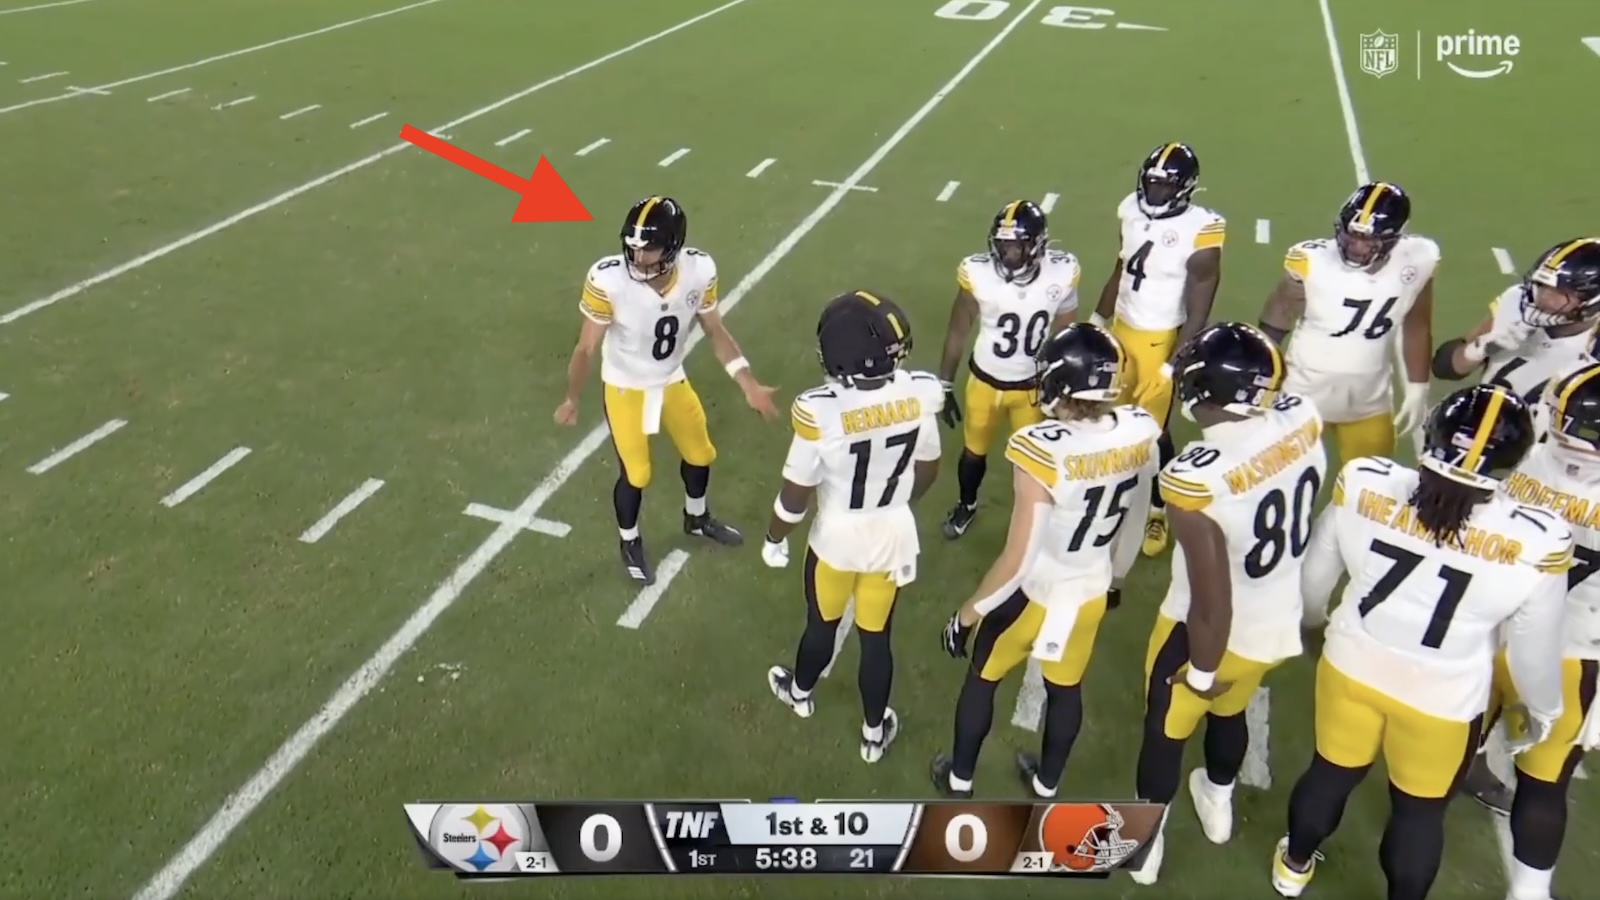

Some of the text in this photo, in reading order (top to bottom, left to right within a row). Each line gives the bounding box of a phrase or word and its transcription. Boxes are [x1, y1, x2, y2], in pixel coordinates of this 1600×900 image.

[1126, 241, 1155, 292] 4
[652, 315, 680, 361] 8
[993, 310, 1050, 359] 30
[1329, 296, 1399, 340] 76
[840, 397, 921, 436] BERNARD
[848, 425, 921, 510] 17
[1177, 446, 1221, 469] 80
[1067, 473, 1139, 552] 15
[1244, 466, 1321, 580] 80
[1358, 538, 1474, 650] 71
